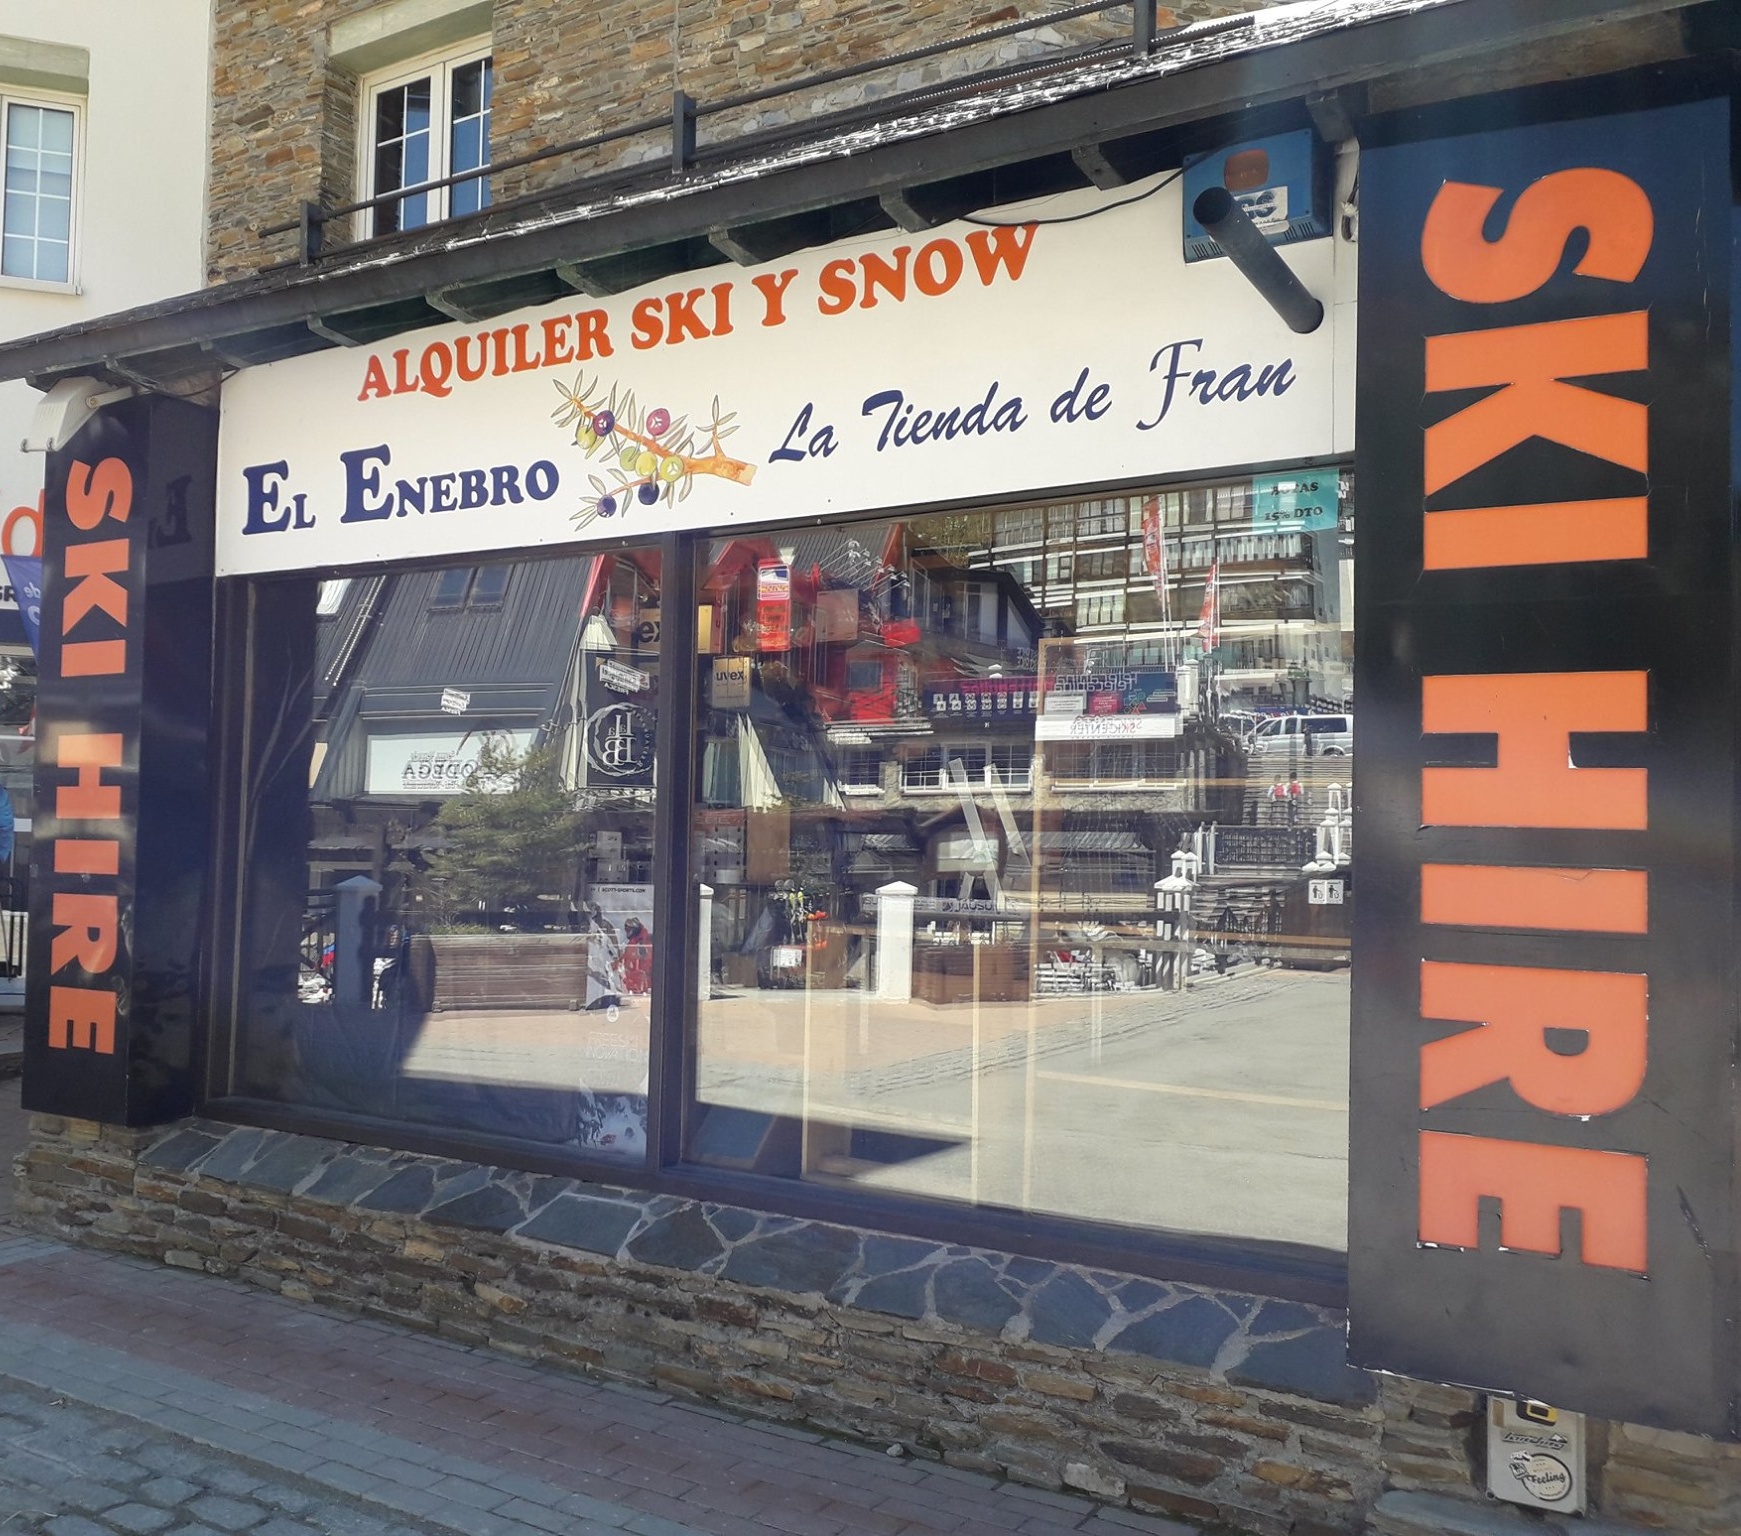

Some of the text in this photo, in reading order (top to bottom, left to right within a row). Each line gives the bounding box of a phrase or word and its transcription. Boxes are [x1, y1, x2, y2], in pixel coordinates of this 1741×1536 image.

[357, 219, 1040, 402] ALQUILER SKI Y SNOW
[768, 337, 1297, 464] La Tienda de Fran
[1264, 506, 1324, 521] 15% DTO
[716, 669, 744, 681] uvex
[1419, 167, 1655, 1272] SKI HIRE
[48, 457, 132, 1054] SKI HIRE
[1525, 1471, 1566, 1484] Feeling
